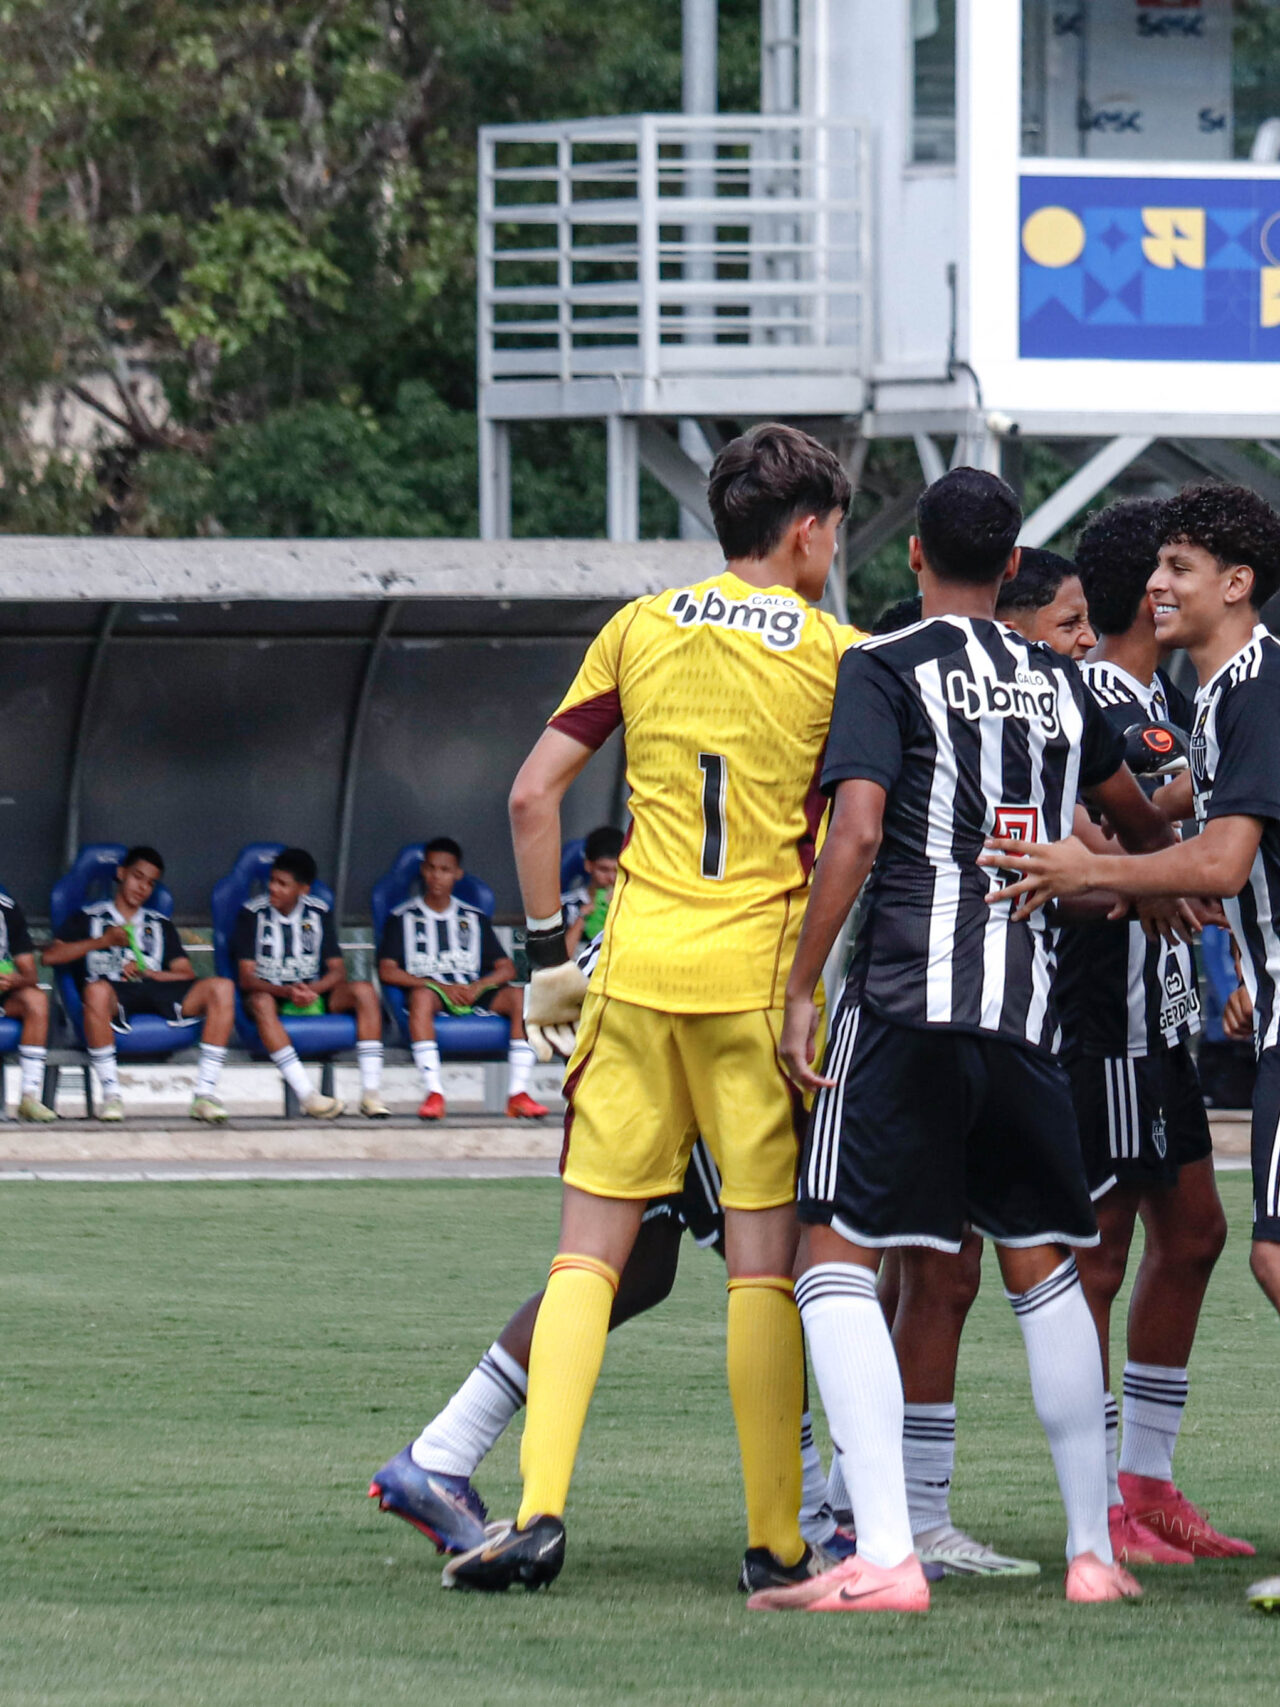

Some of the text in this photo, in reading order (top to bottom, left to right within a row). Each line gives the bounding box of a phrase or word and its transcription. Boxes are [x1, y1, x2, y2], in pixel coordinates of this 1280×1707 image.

[700, 591, 800, 647] bmg
[752, 596, 794, 607] GALO
[1017, 673, 1044, 686] GALO
[983, 675, 1055, 734] bmg
[698, 752, 728, 880] 1
[1160, 991, 1199, 1030] GERDAU
